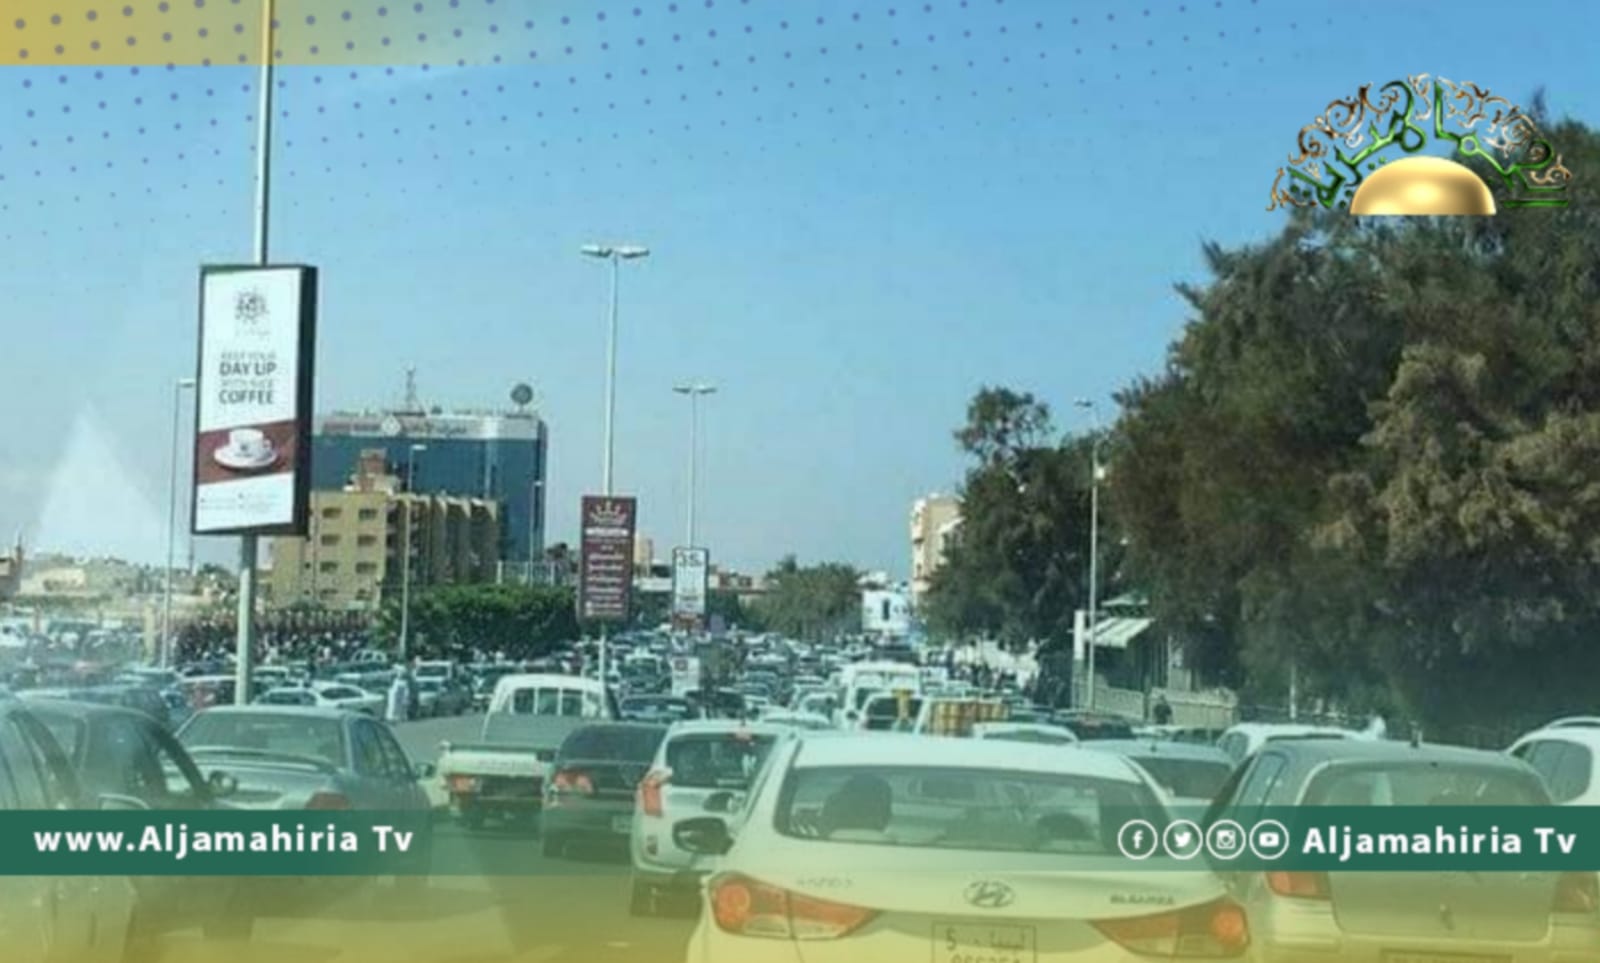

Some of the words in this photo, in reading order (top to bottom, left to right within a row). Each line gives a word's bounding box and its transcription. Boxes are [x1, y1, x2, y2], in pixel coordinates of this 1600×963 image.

[219, 361, 250, 377] DAY
[253, 361, 278, 377] UP
[218, 388, 276, 406] COFFEE
